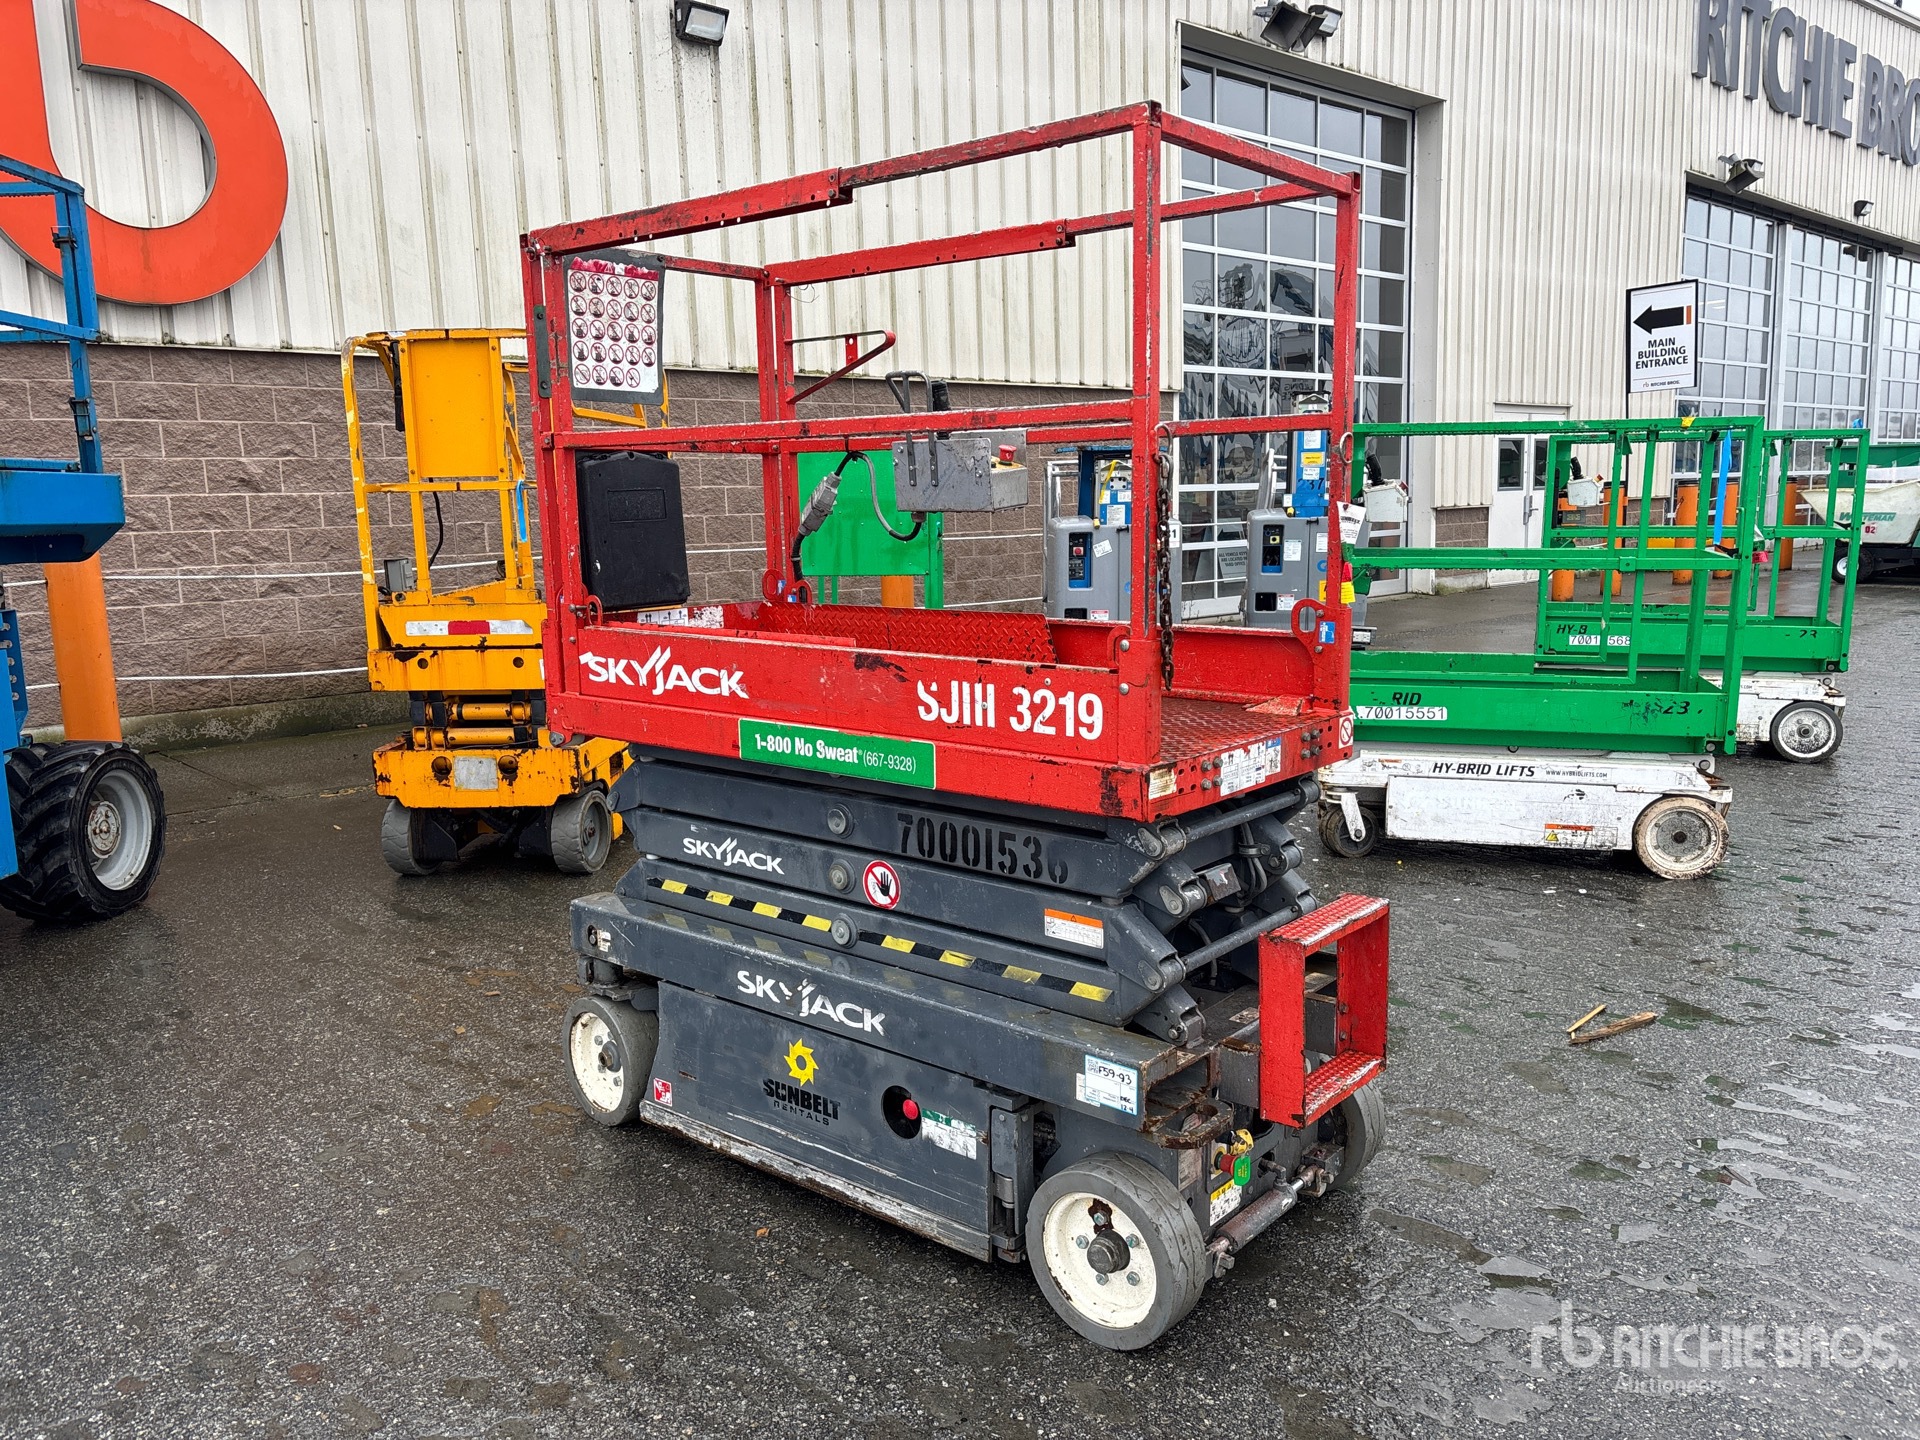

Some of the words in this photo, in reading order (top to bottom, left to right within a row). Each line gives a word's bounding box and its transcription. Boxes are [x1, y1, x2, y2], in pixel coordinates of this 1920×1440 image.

[1691, 0, 1857, 139] RITCHIE
[1635, 355, 1689, 370] ENTRANCE
[1637, 346, 1687, 360] BUILDING
[1648, 337, 1676, 349] MAIN
[1839, 512, 1897, 521] WTEMAN
[579, 645, 750, 699] SKYJACK
[1009, 686, 1104, 741] 3219
[755, 733, 792, 752] 1-800
[795, 737, 813, 757] No
[863, 749, 917, 775] (667-9328)
[1432, 762, 1492, 776] HY-BRID
[1496, 763, 1536, 778] LIFTS
[682, 836, 785, 875] SKYJACK
[737, 970, 886, 1036] SKYJACK
[762, 1078, 841, 1121] SUNBELT
[773, 1099, 831, 1127] RENTALS
